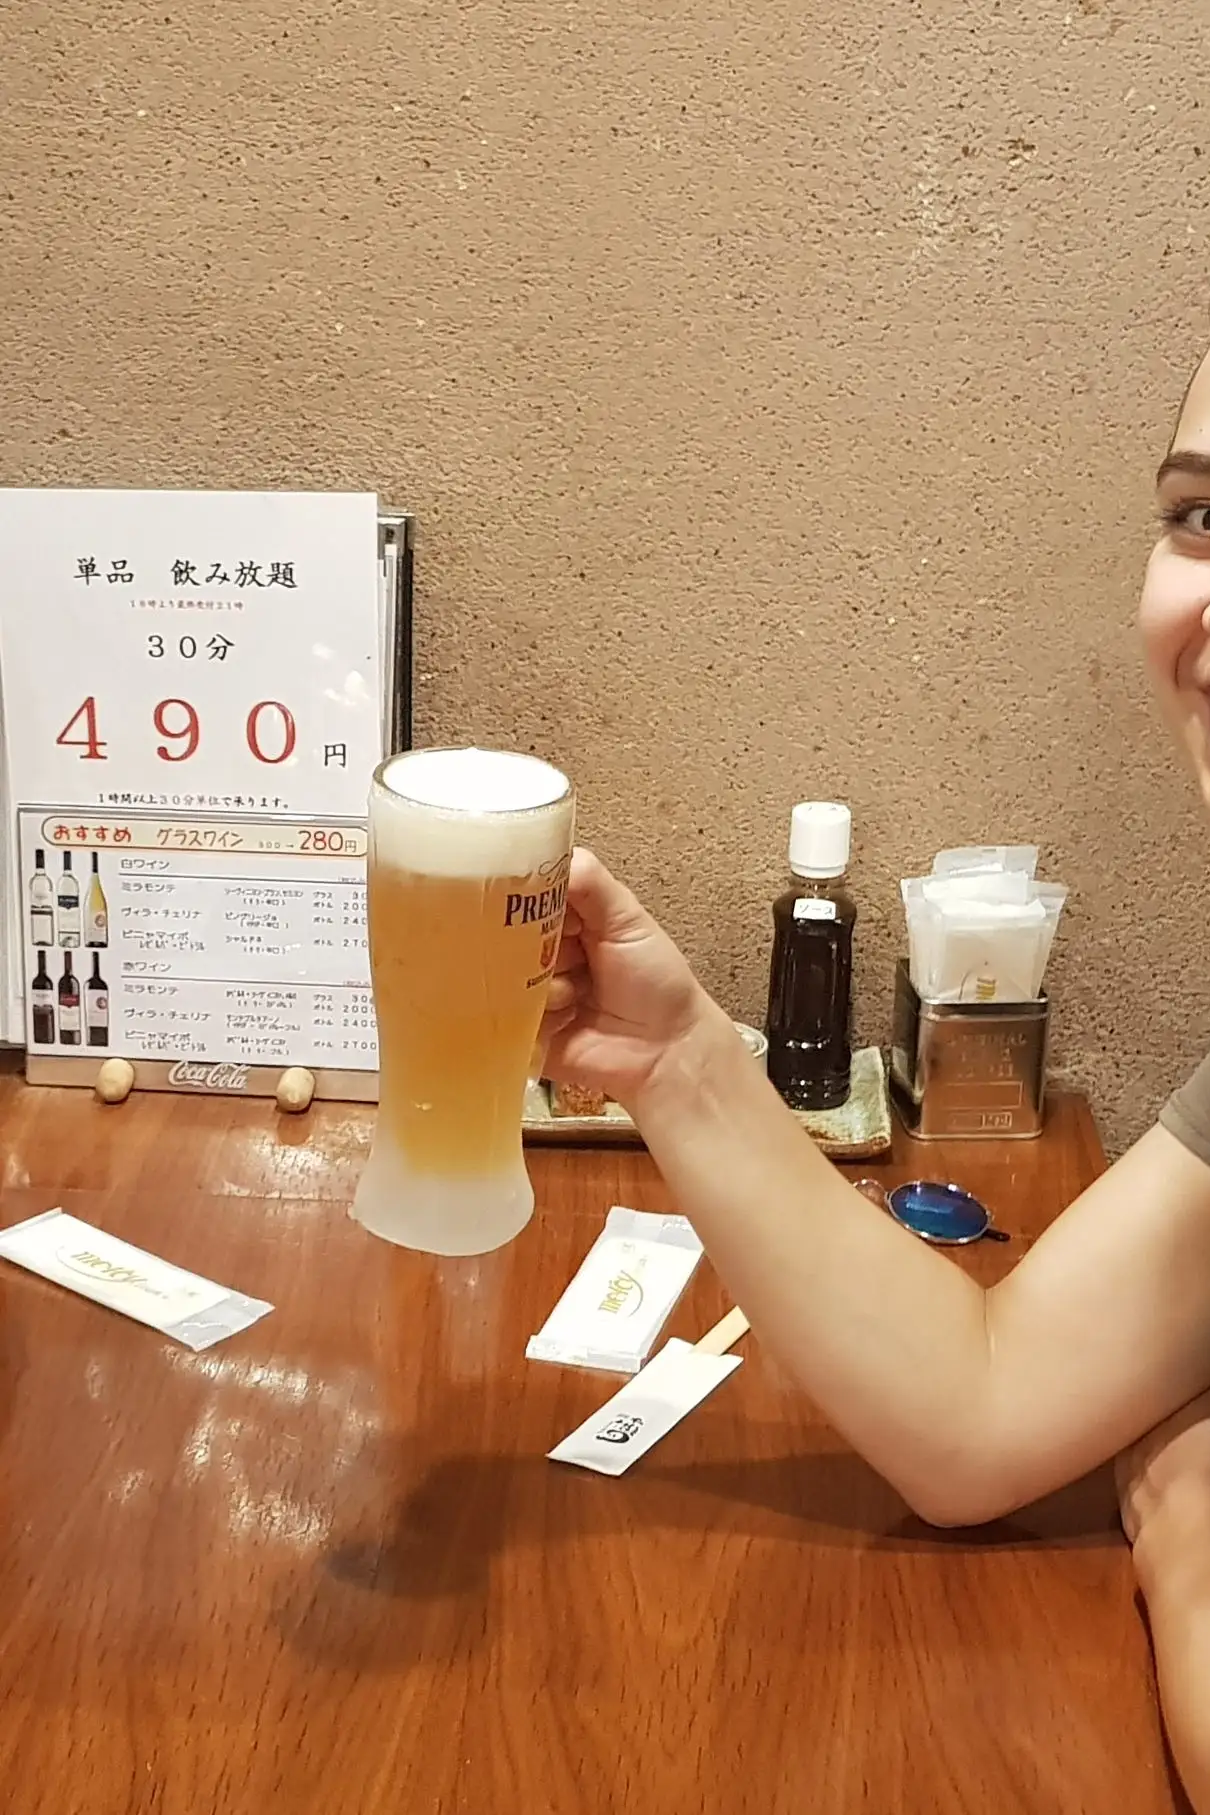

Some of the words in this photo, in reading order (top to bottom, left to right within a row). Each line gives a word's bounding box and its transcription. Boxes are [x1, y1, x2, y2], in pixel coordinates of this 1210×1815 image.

[74, 557, 134, 586] 単品
[171, 559, 298, 588] 飲み放題
[148, 633, 235, 661] 30分
[53, 825, 132, 843] おすすめ
[157, 828, 244, 848] グラスワイン
[121, 859, 170, 870] 白ワイン
[168, 1060, 252, 1090] Coca-Cola
